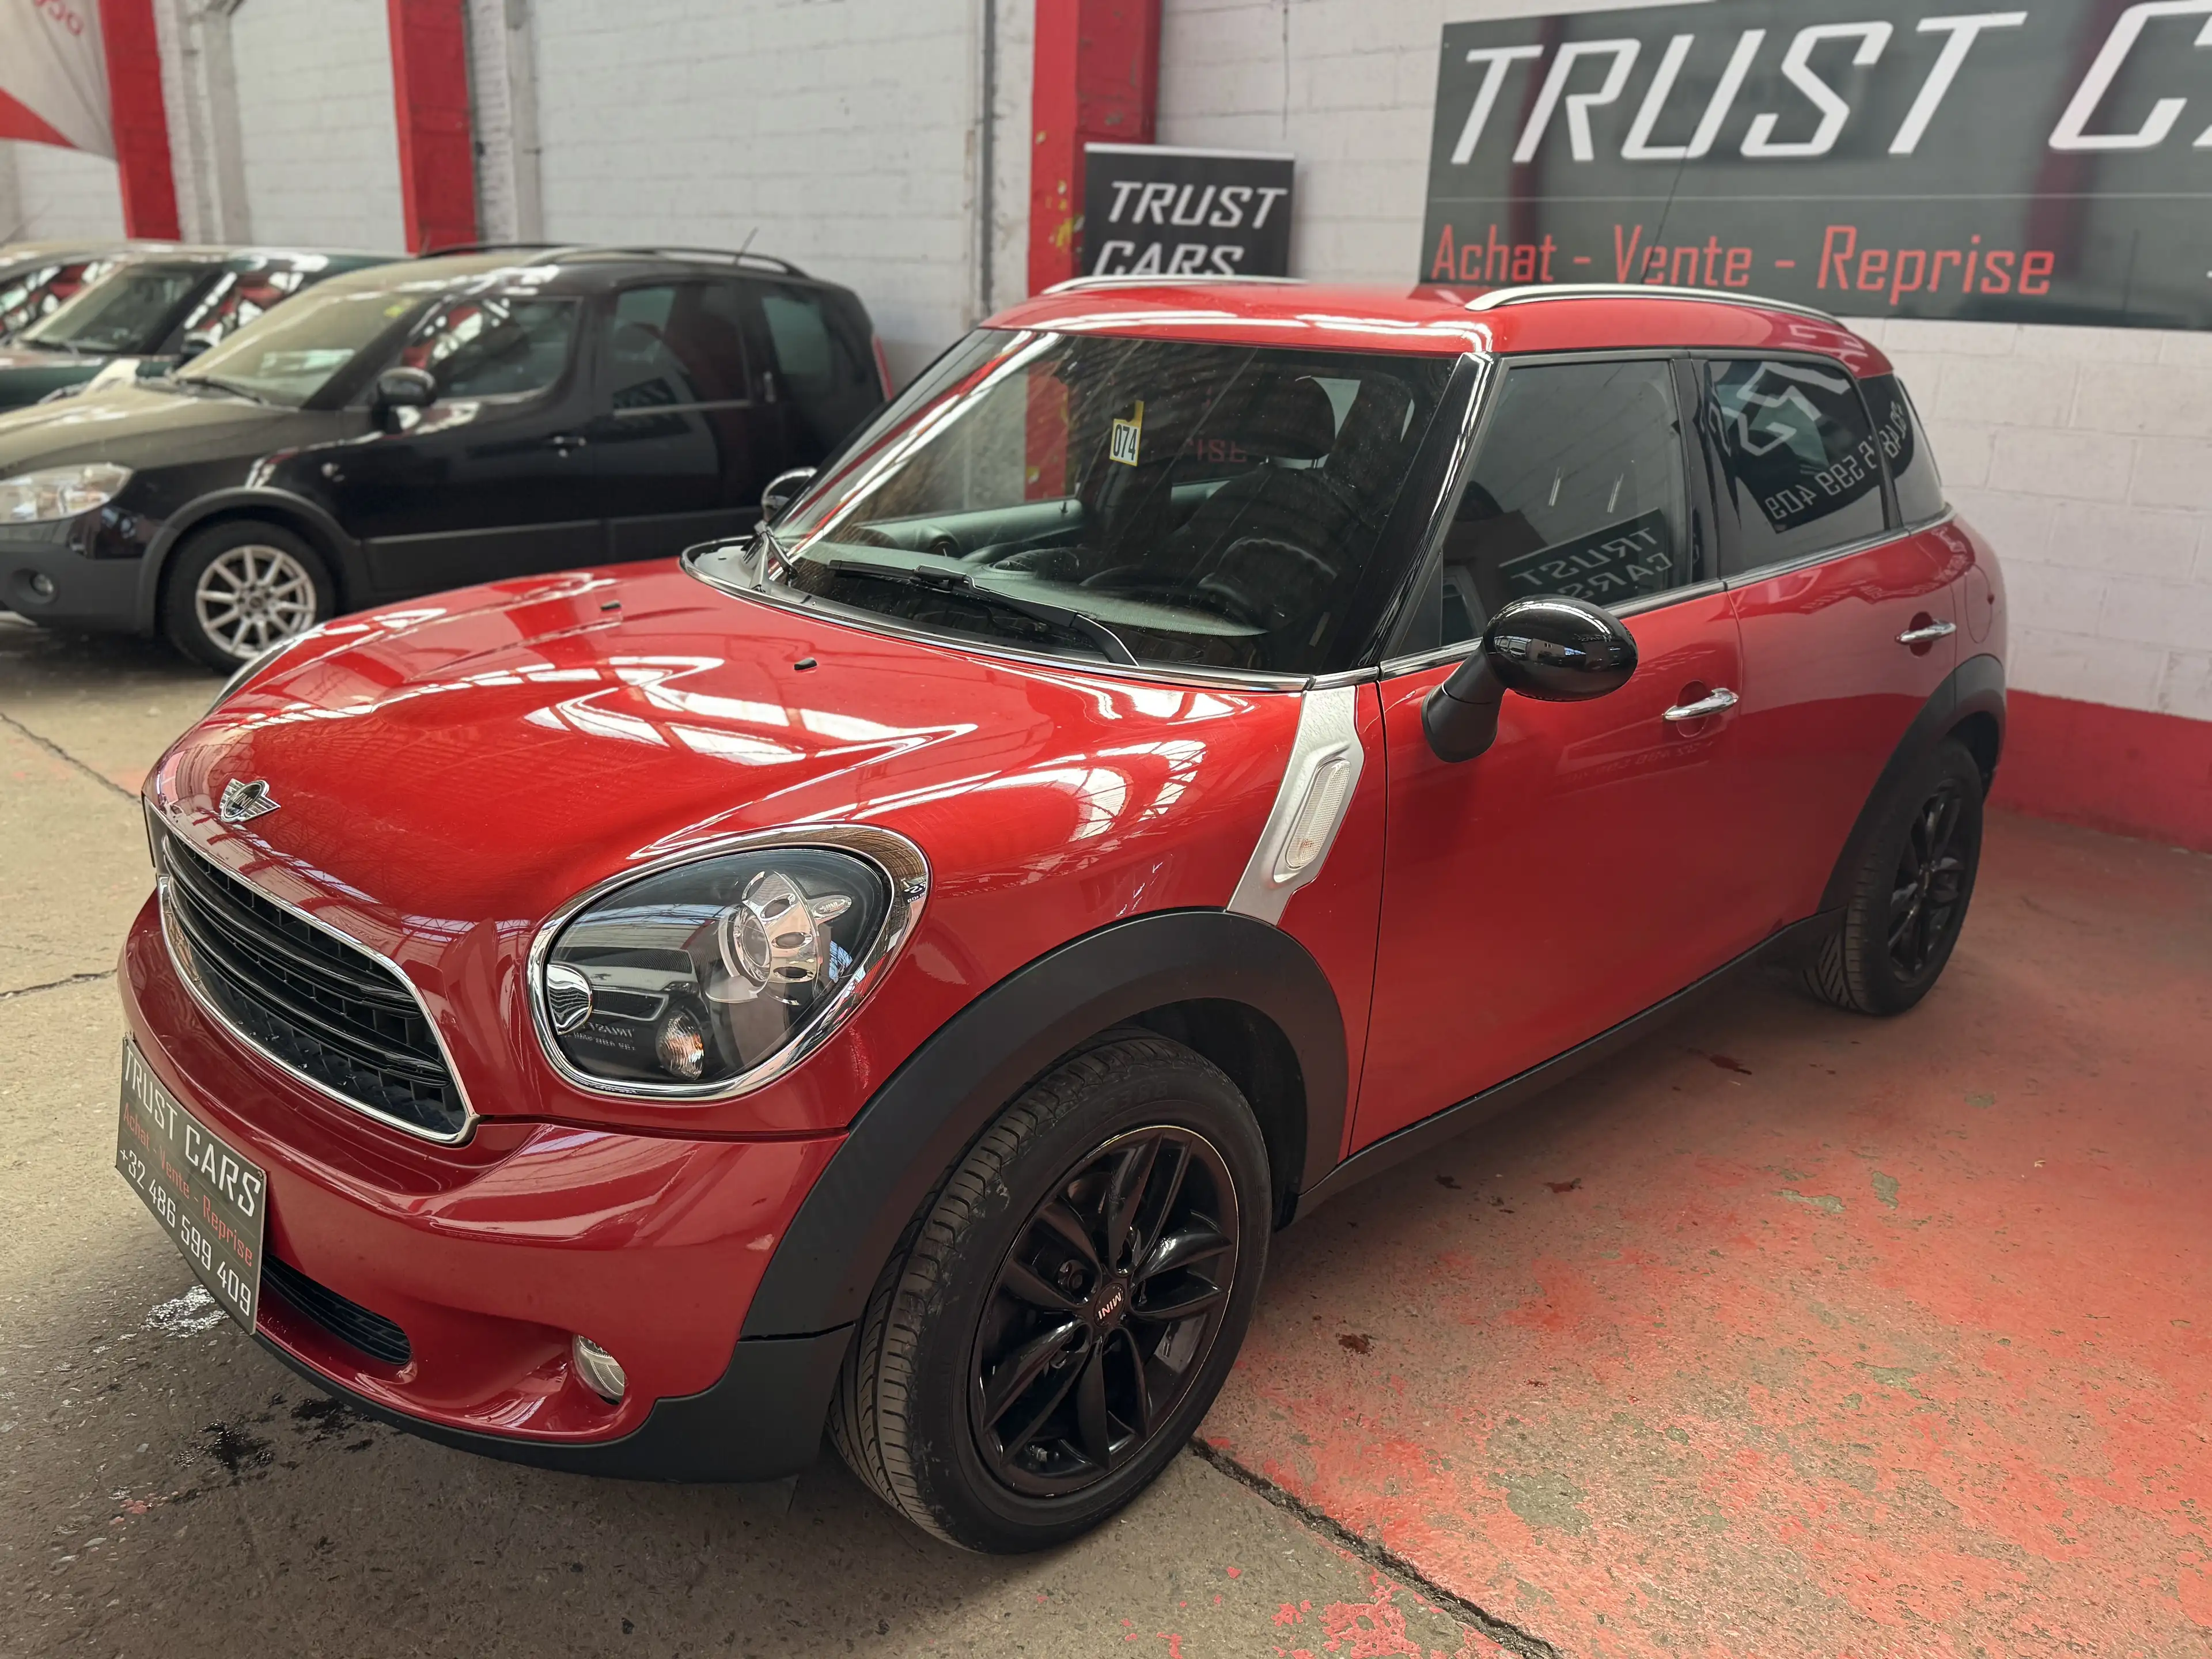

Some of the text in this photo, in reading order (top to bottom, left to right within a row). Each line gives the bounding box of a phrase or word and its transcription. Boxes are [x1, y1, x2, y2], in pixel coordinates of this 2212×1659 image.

[1451, 0, 2212, 164] TRUST C
[1108, 181, 1288, 229] TRUST
[1092, 240, 1244, 276] CARS
[1431, 224, 1557, 282] Achat
[1614, 225, 1752, 287] Vente
[1817, 225, 2055, 306] Reprise
[1113, 423, 1138, 461] 074
[124, 1045, 261, 1217] TRUST CARS
[123, 1102, 150, 1152] Achat
[159, 1143, 190, 1199] Vente
[203, 1194, 253, 1267] Reprise
[119, 1149, 252, 1317] +32 486 599 409
[1098, 1291, 1122, 1320] MINI
